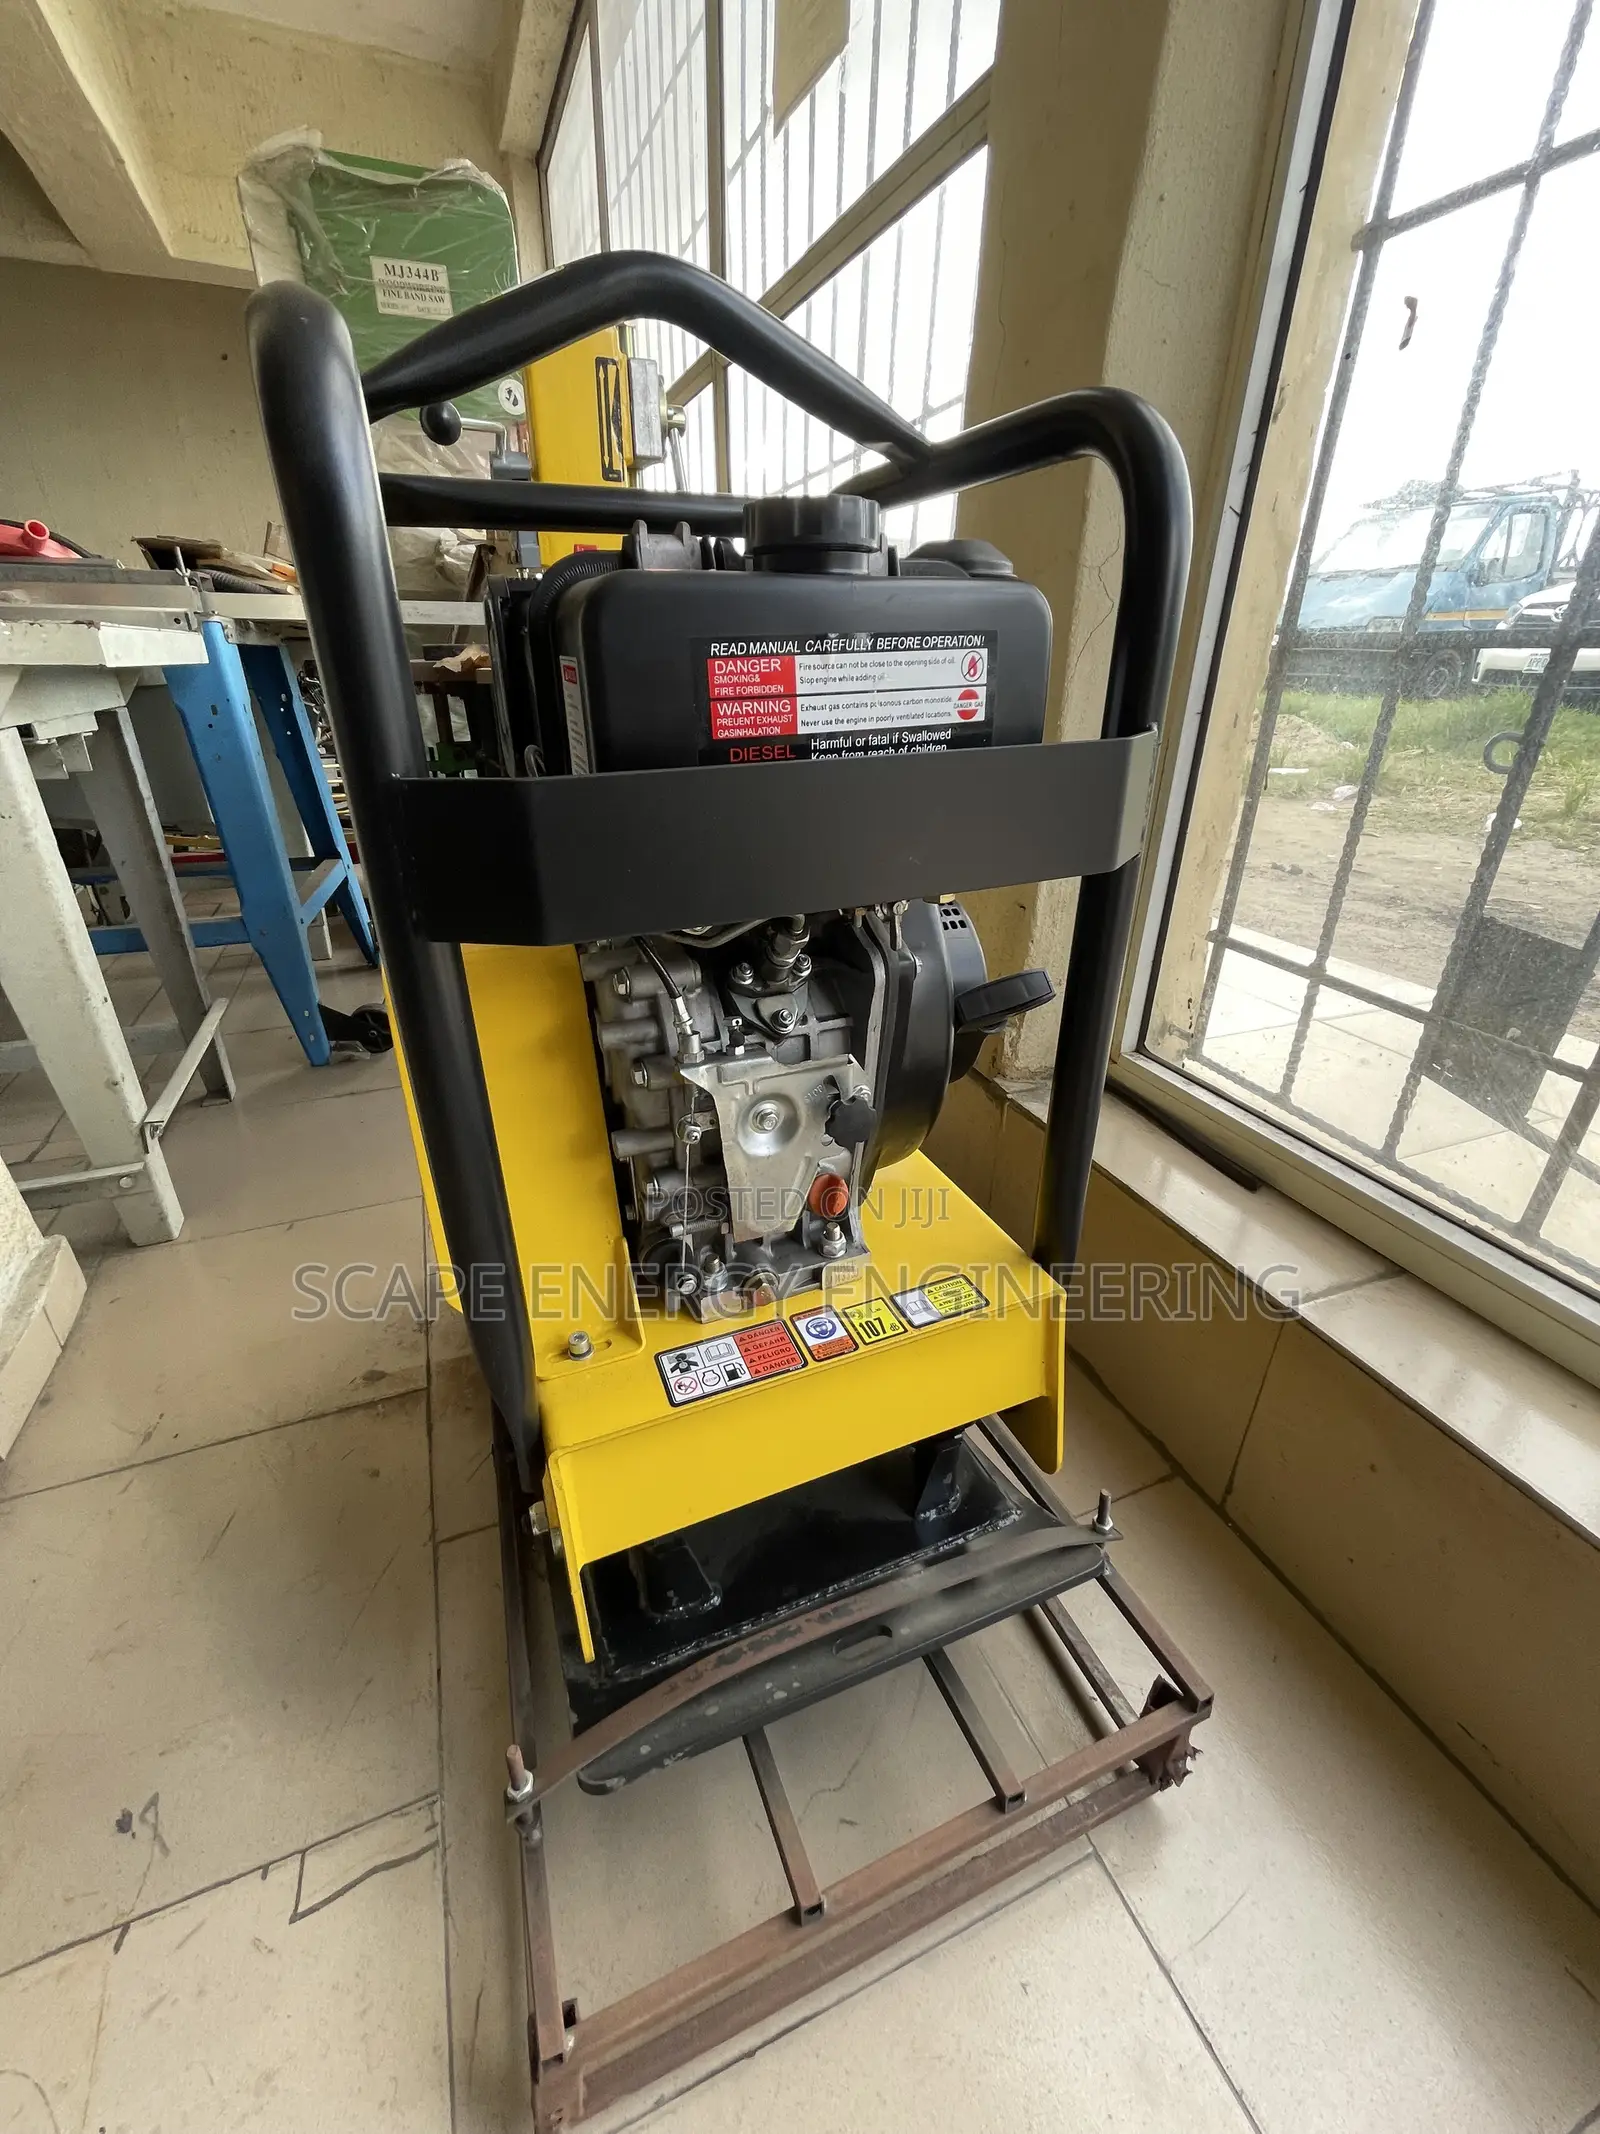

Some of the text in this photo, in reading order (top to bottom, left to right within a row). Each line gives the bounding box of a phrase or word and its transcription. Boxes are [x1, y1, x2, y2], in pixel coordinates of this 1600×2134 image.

[384, 263, 439, 281] MJ344B
[404, 291, 427, 302] BAND
[428, 295, 446, 304] SAW
[710, 634, 985, 656] READ MANUAL CAREFULLY BEFORE OPERATION!
[714, 658, 782, 674] DANGER
[799, 662, 812, 671] Fire
[812, 661, 835, 671] source
[836, 661, 848, 669] can
[848, 659, 859, 668] not
[860, 660, 868, 668] be
[868, 658, 886, 668] close
[886, 658, 893, 667] to
[894, 657, 903, 667] the
[904, 656, 927, 667] opening
[928, 656, 940, 664] side
[940, 655, 948, 664] of
[713, 673, 760, 685] SMOKING&
[815, 674, 837, 685] engine
[838, 673, 854, 683] while
[855, 671, 876, 683] adding
[714, 685, 784, 696] FIRE FORBIDDEN
[716, 699, 791, 716] WARNING
[800, 703, 827, 712] Exhaust
[828, 704, 840, 712] gas
[841, 701, 868, 710] contains
[902, 697, 924, 706] carbon
[756, 713, 793, 724] EXHAUST
[800, 719, 820, 727] Never
[834, 717, 844, 725] the
[846, 716, 867, 726] engine
[868, 714, 875, 722] in
[876, 713, 895, 724] poorly
[896, 710, 924, 720] ventilated
[717, 726, 780, 738] GASINHALATION
[810, 728, 952, 751] Harmful or fatal if Swallowed
[729, 745, 797, 763] DIESEL
[934, 1279, 963, 1292] CAUTION
[747, 1326, 780, 1340] DANGER
[859, 1317, 887, 1339] 107
[890, 1322, 900, 1332] dB
[752, 1336, 786, 1351] GEFAHR
[757, 1346, 791, 1361] PELIGRO
[762, 1357, 797, 1372] DANGER
